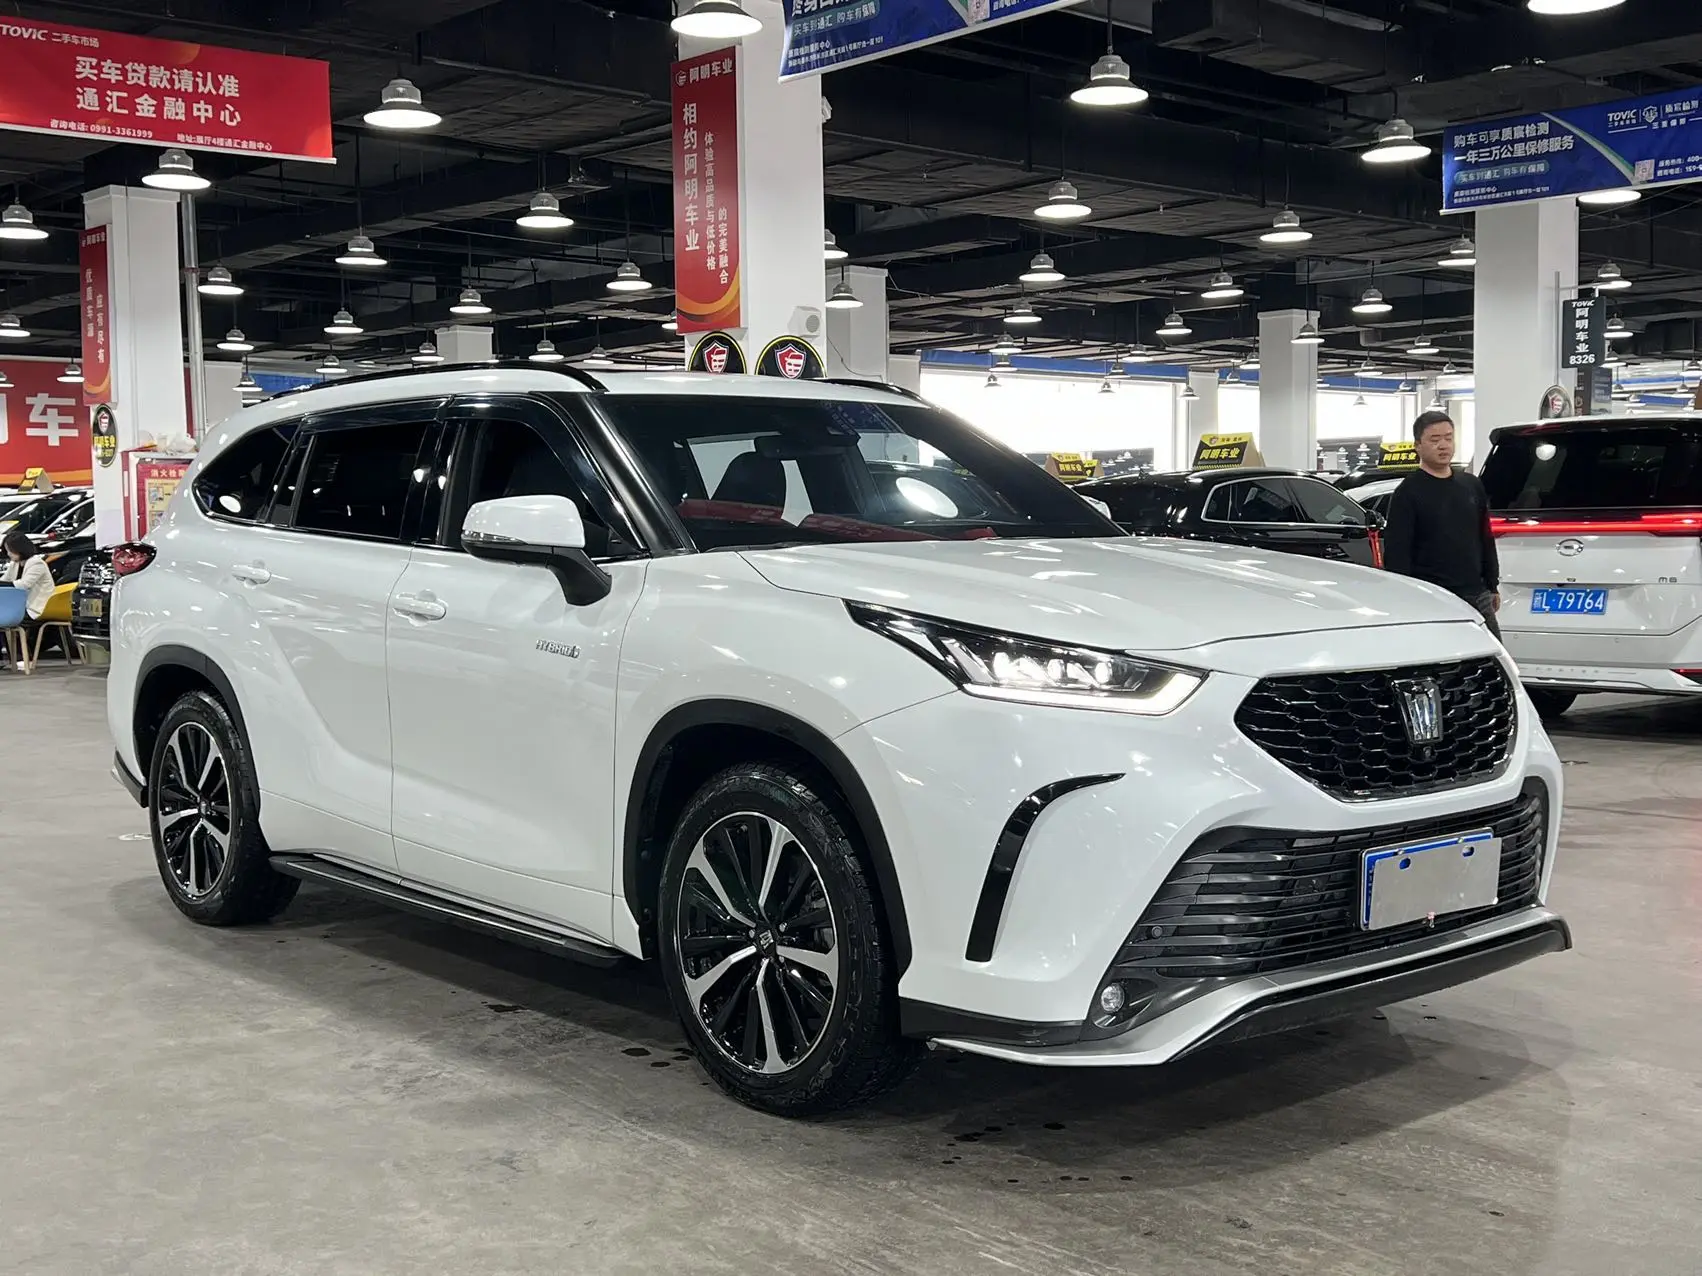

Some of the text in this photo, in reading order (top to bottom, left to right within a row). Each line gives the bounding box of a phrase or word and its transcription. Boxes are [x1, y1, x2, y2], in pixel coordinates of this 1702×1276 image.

[0, 24, 99, 48] TOVIC 二手车市场
[75, 56, 240, 97] 买车贷款请认准
[689, 57, 733, 84] 阿明车业
[76, 87, 241, 127] 通汇金融中心
[1608, 109, 1637, 122] TOVIC
[90, 124, 152, 138] 0991-3361999
[1454, 135, 1574, 164] 一年三万公里保修服务
[683, 103, 700, 251] 相约阿明车业
[704, 132, 716, 270] 体验高品质与低价格
[718, 207, 729, 284] 的完美融合
[1571, 300, 1595, 308] TOVIC
[1575, 307, 1589, 353] 阿明车业
[1569, 354, 1596, 365] 8326
[0, 392, 79, 447] 车
[1200, 447, 1240, 460] 阿明车业
